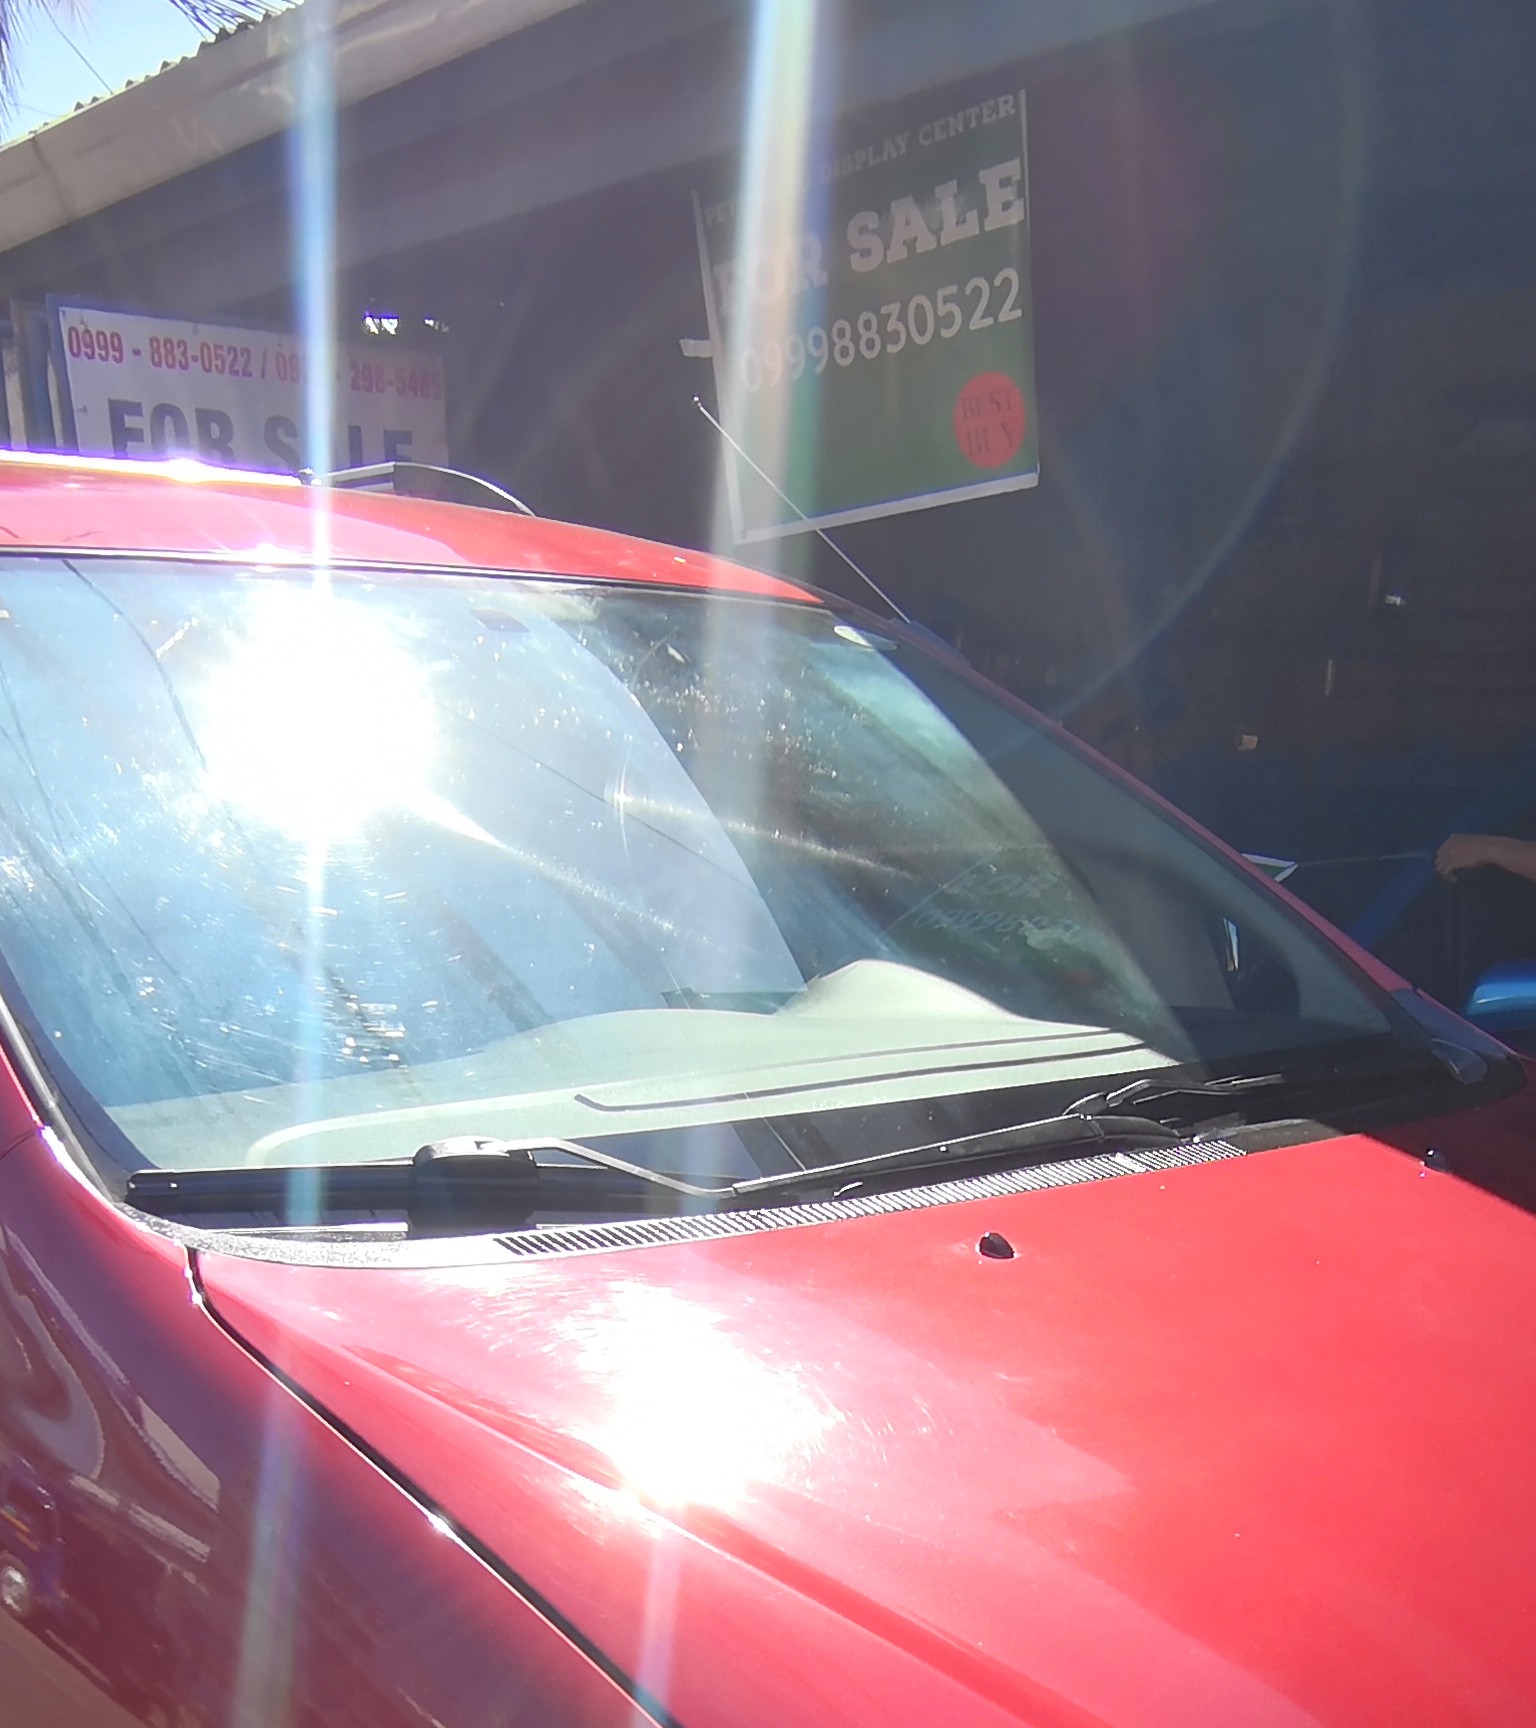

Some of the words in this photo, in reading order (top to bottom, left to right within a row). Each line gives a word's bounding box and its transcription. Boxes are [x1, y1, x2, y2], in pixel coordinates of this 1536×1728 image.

[919, 94, 1017, 147] CENTER
[846, 157, 1026, 273] SALE
[67, 325, 125, 364] 0999
[149, 334, 253, 378] 883-0522
[739, 267, 1024, 394] 09998830522
[960, 386, 1016, 420] BEST
[967, 420, 1017, 457] BUY
